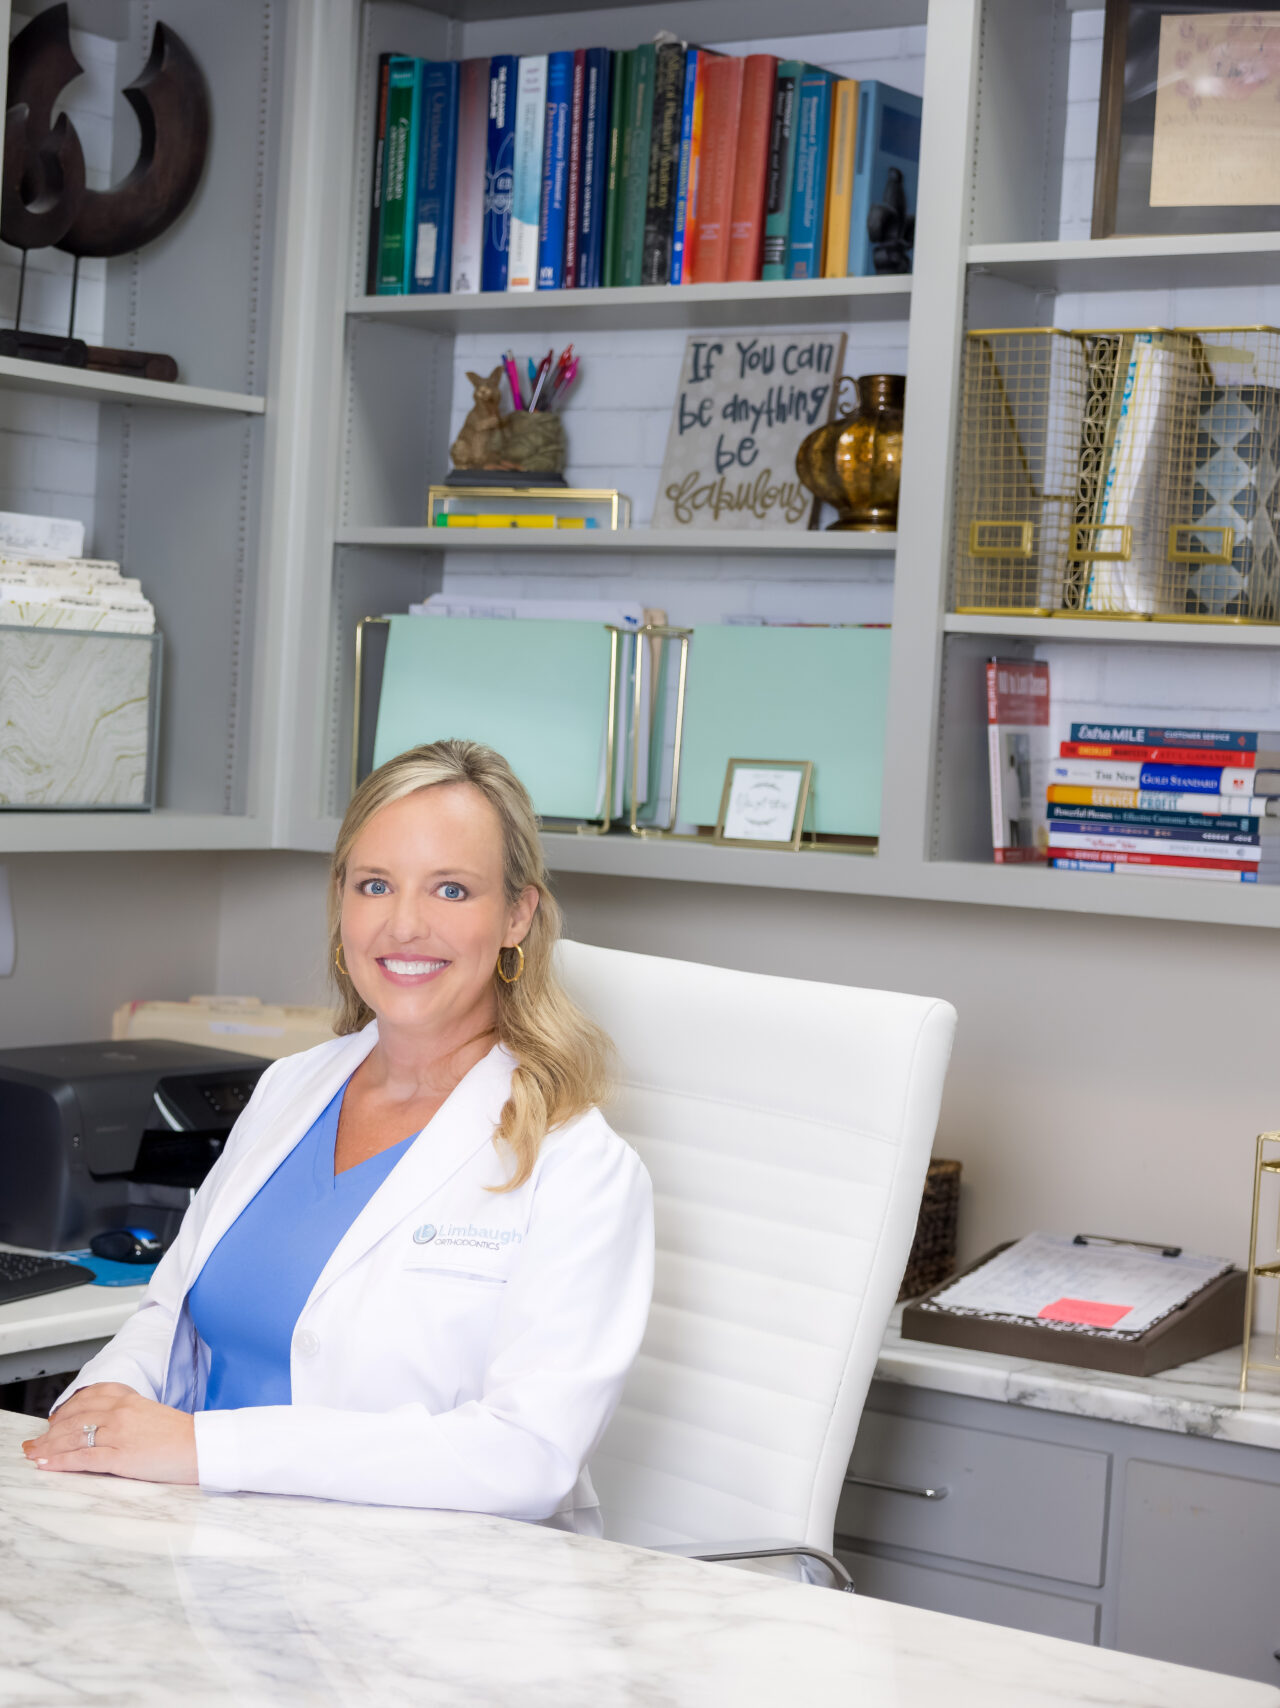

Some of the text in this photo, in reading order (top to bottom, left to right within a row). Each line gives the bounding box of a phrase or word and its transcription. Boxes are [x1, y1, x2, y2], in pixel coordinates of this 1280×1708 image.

[661, 102, 677, 150] Human
[657, 152, 673, 209] Anatomy
[736, 338, 777, 379] You
[678, 384, 830, 436] be anything
[715, 435, 760, 474] be
[1111, 728, 1145, 743] MILE
[1164, 730, 1202, 740] CUSTOMER
[1202, 732, 1231, 742] SERVICE
[1153, 814, 1187, 826] Customer
[1188, 816, 1213, 827] Service
[434, 1237, 501, 1251] ORTHODONTICS
[437, 1223, 523, 1246] Limbaugh
